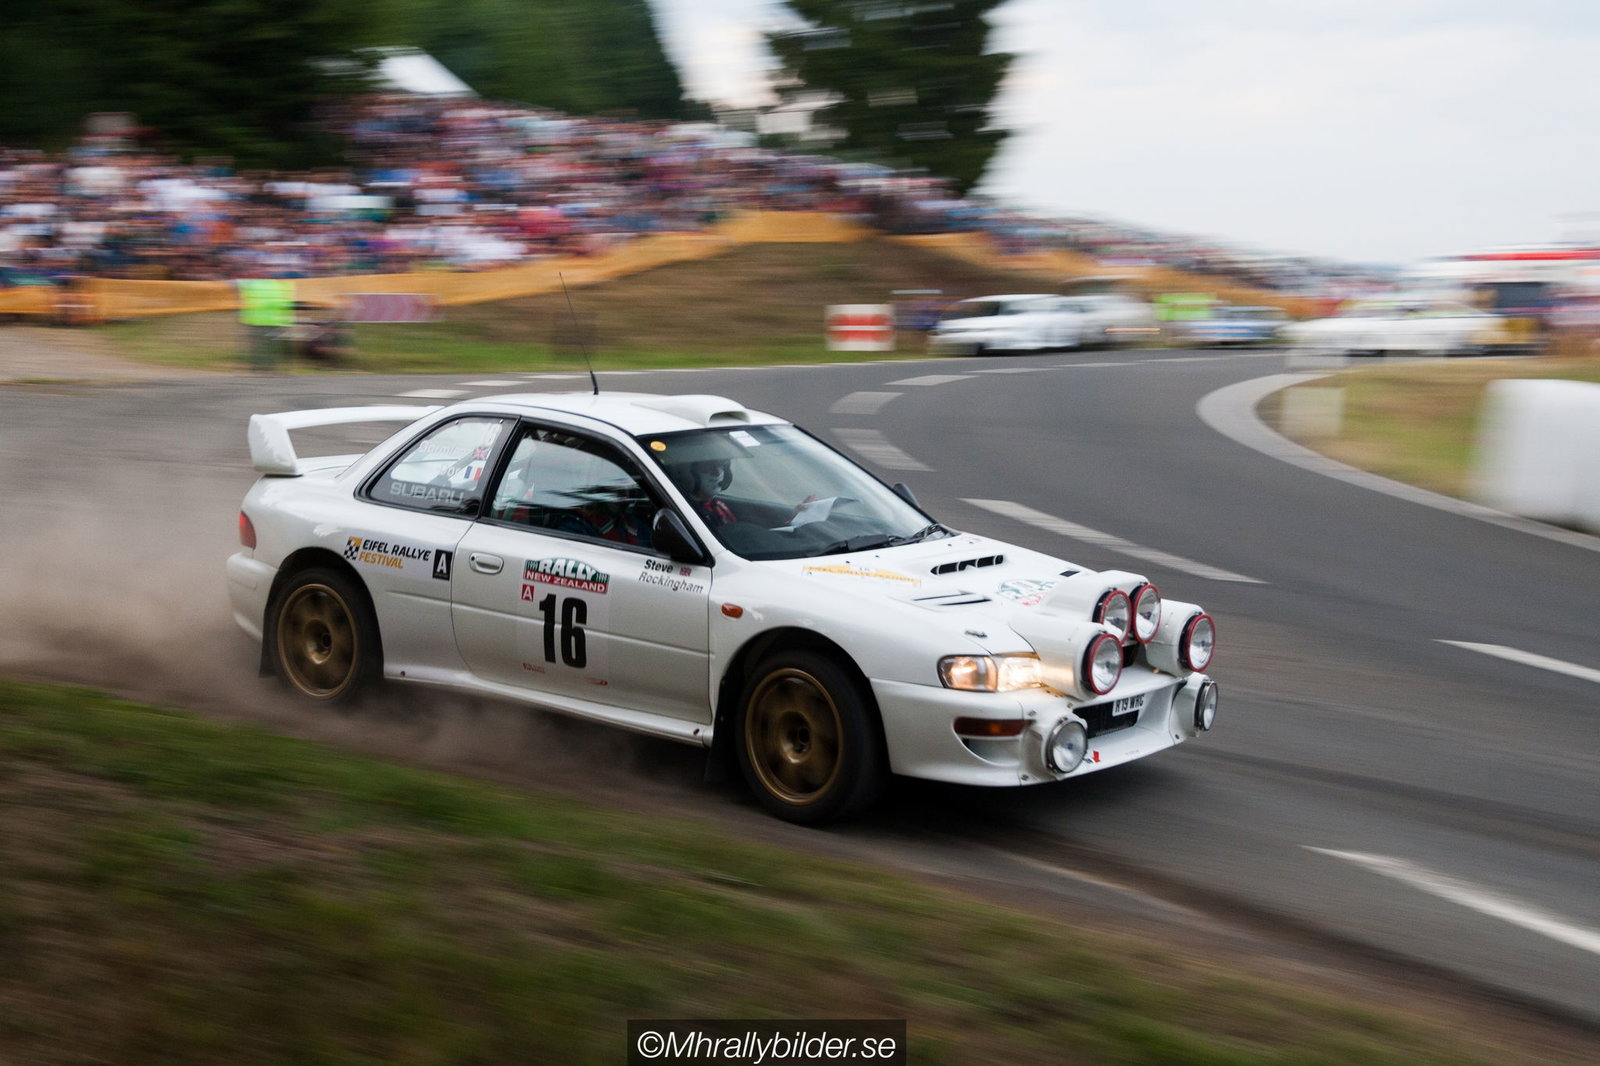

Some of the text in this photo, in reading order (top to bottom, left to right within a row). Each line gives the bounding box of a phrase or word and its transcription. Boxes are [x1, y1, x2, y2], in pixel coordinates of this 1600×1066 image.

[389, 481, 465, 504] SUBARU
[359, 551, 404, 569] FESTIVAL
[362, 539, 431, 561] EIFEL RALLYE
[436, 553, 447, 574] A
[538, 558, 596, 581] RALLY
[644, 559, 673, 573] Steve
[526, 570, 606, 593] NEW ZEALAND
[638, 571, 703, 593] Rockingham
[522, 586, 533, 601] A
[539, 593, 587, 669] 16
